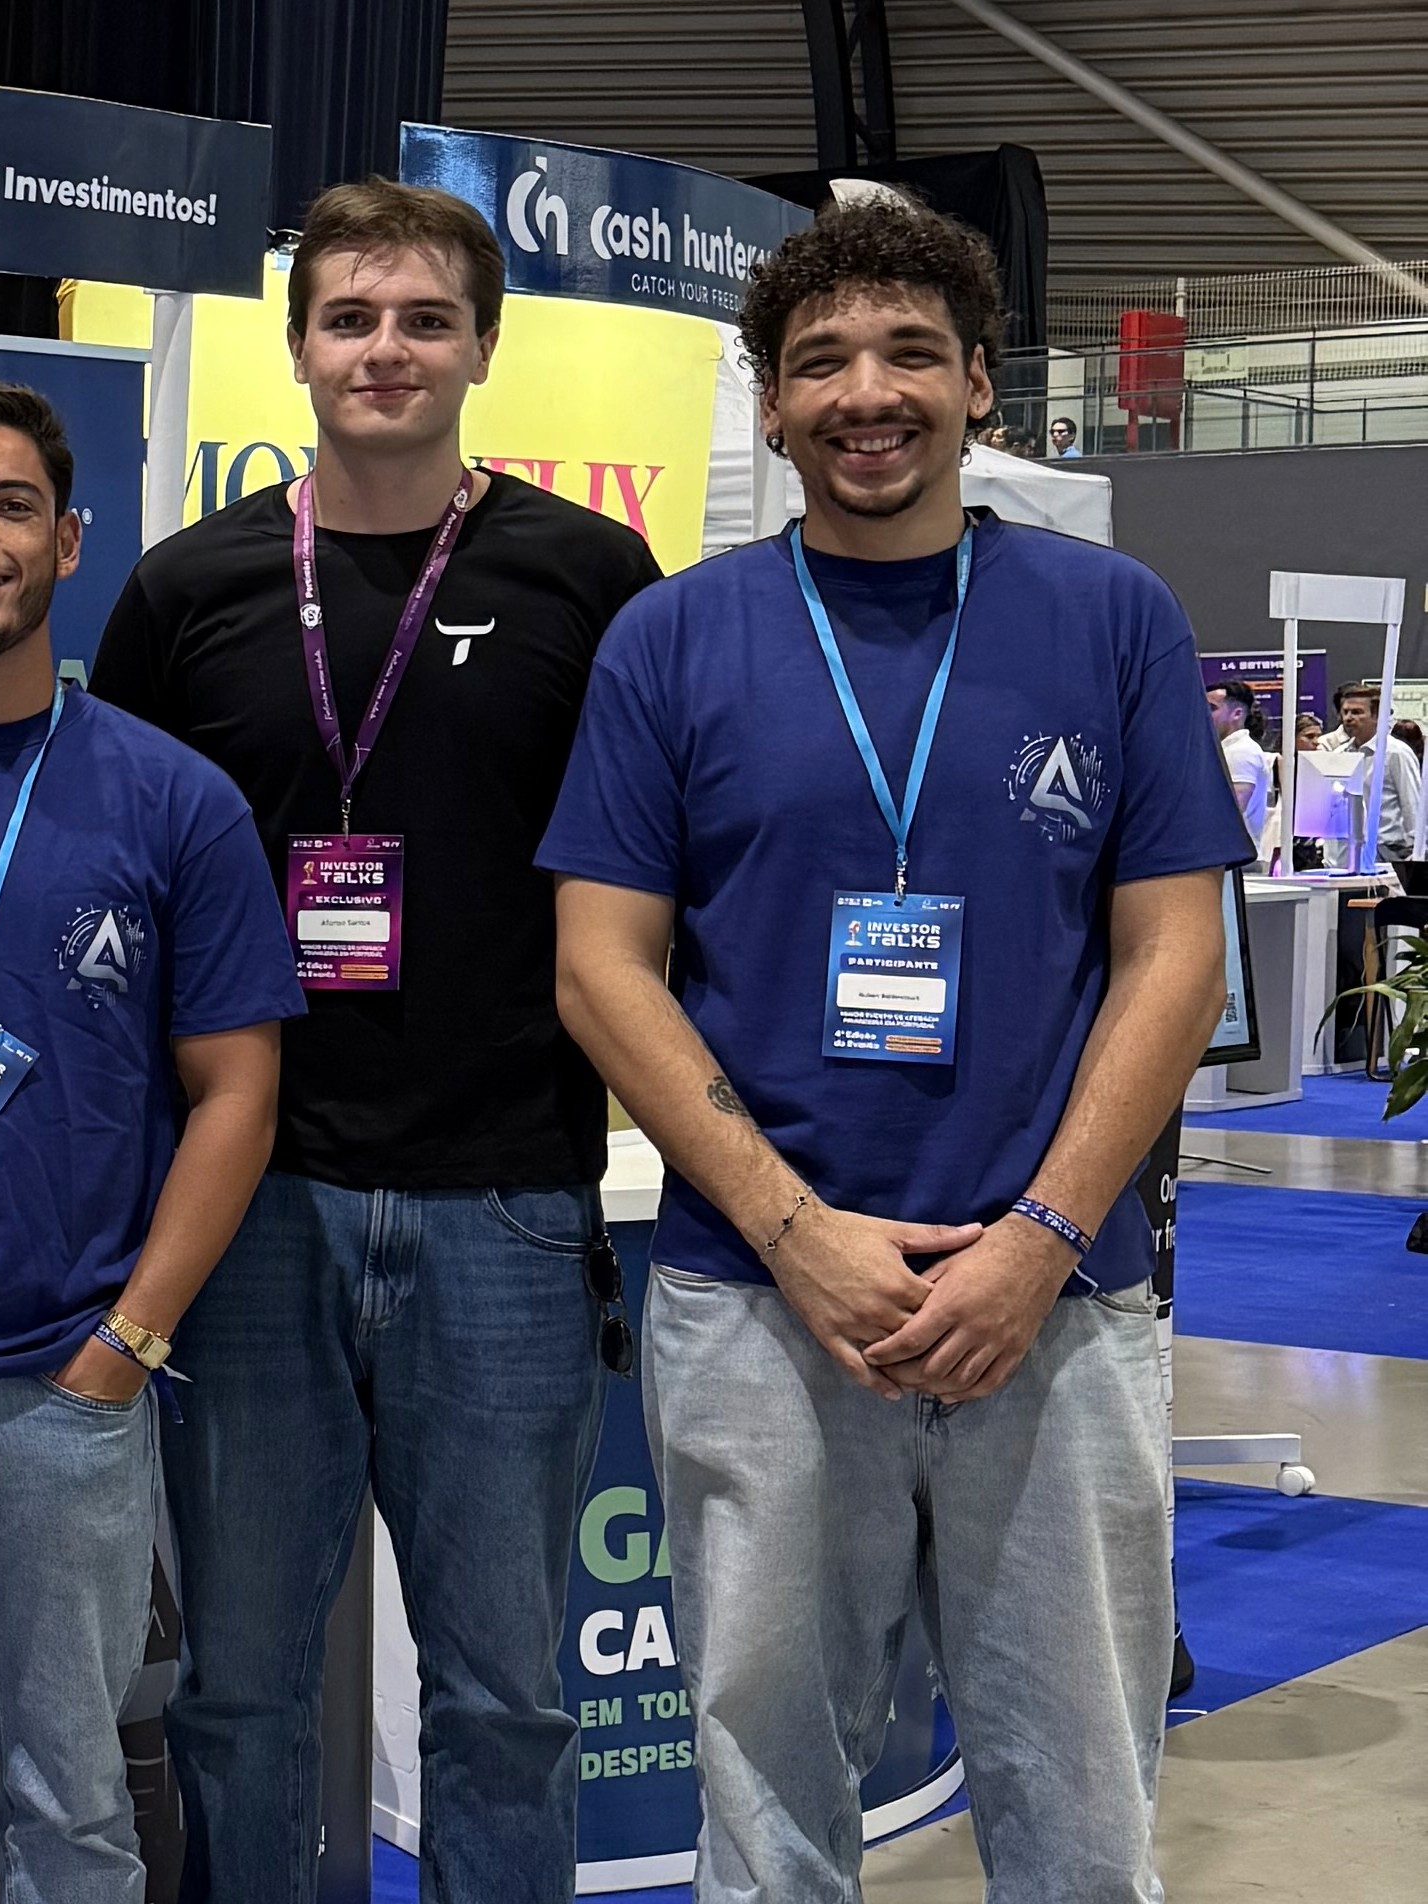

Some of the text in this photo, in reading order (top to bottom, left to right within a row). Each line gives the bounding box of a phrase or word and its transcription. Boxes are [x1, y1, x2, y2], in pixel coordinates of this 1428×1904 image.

[4, 166, 218, 227] Investimentos!
[631, 272, 743, 313] CATCH YOUR FREED
[320, 861, 384, 871] INVESTOR
[867, 921, 941, 935] INVESTOR
[579, 1605, 681, 1675] CA
[580, 1697, 622, 1728] EM
[580, 1740, 696, 1781] DESPES
